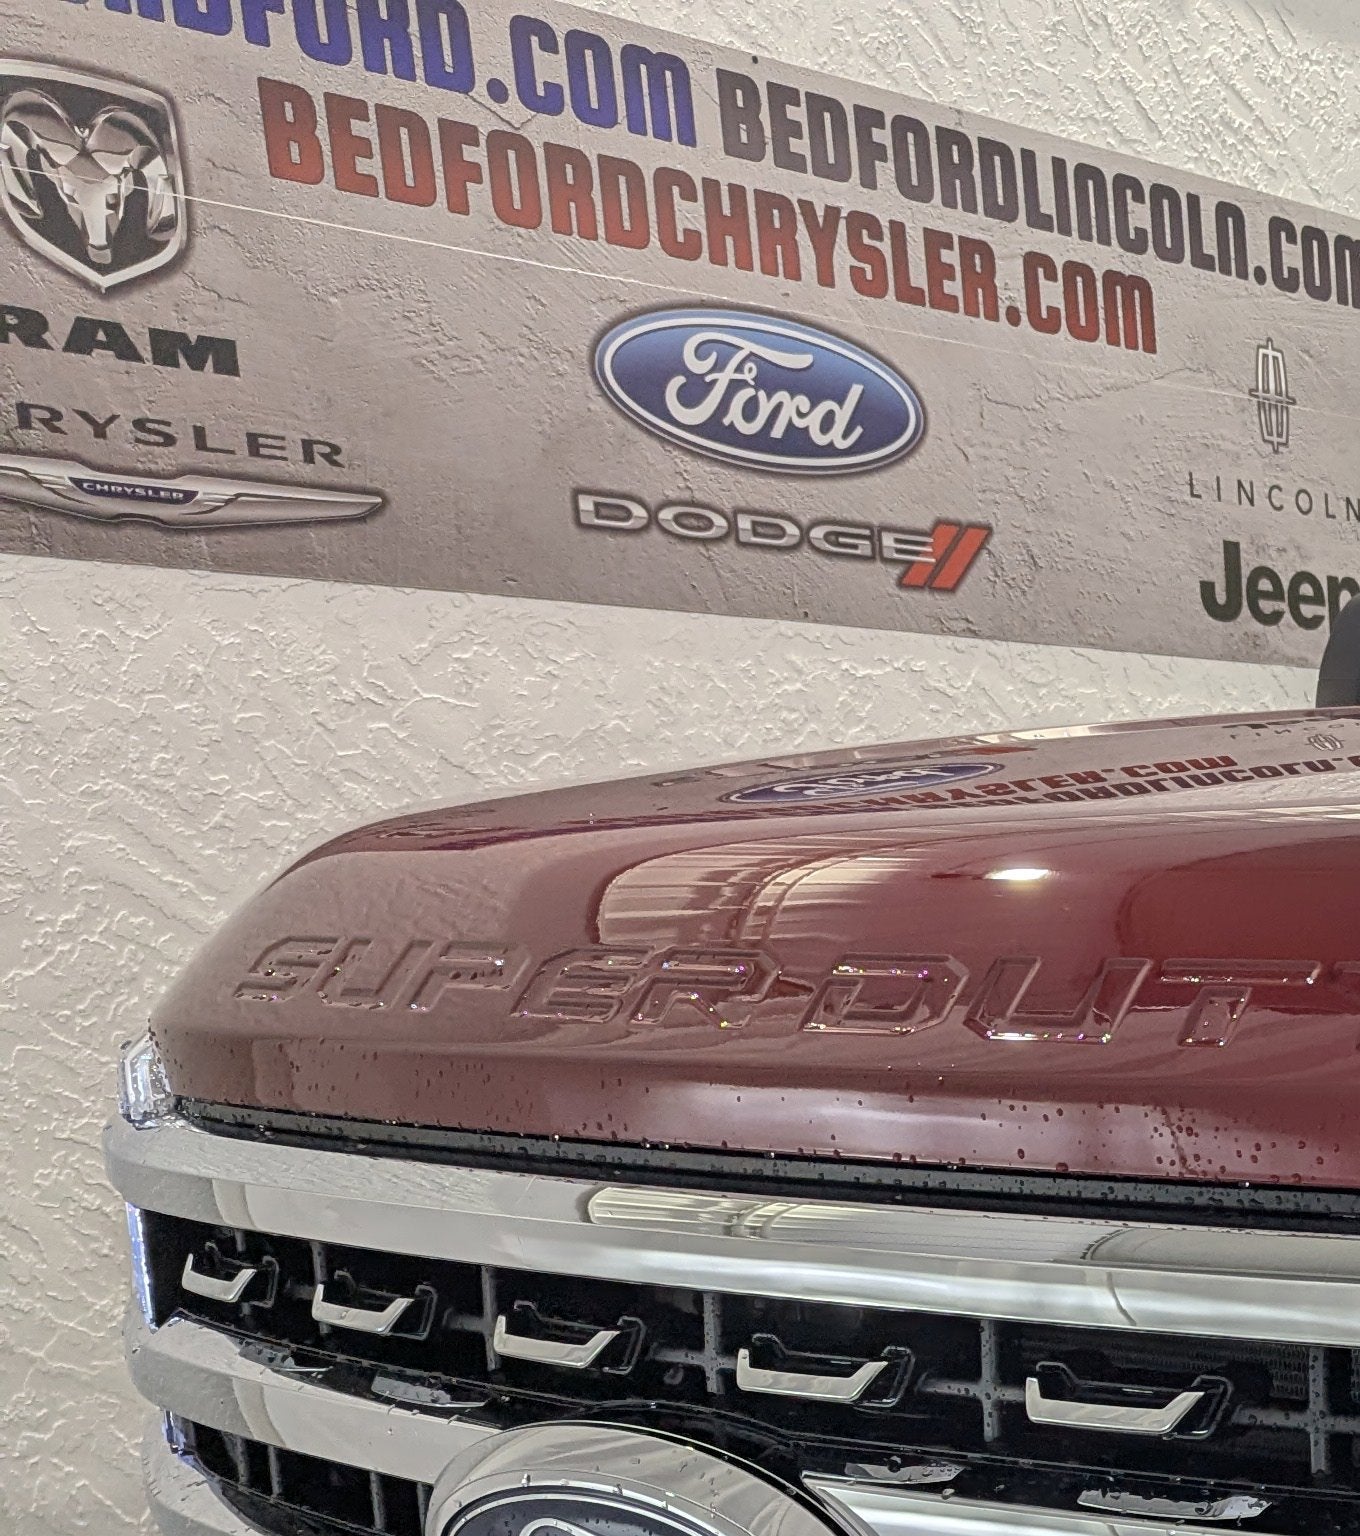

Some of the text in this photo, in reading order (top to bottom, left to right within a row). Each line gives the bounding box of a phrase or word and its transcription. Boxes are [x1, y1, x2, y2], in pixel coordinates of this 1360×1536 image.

[58, 0, 697, 148] ORD.COM
[256, 76, 1157, 355] BEDFORDCHRYSLER.COM
[0, 303, 241, 378] RAM
[664, 331, 865, 451] Ford
[15, 400, 346, 469] RYSLER
[81, 481, 185, 502] CHRYSLER
[576, 492, 937, 563] DODGE
[233, 934, 782, 1030] SUPER
